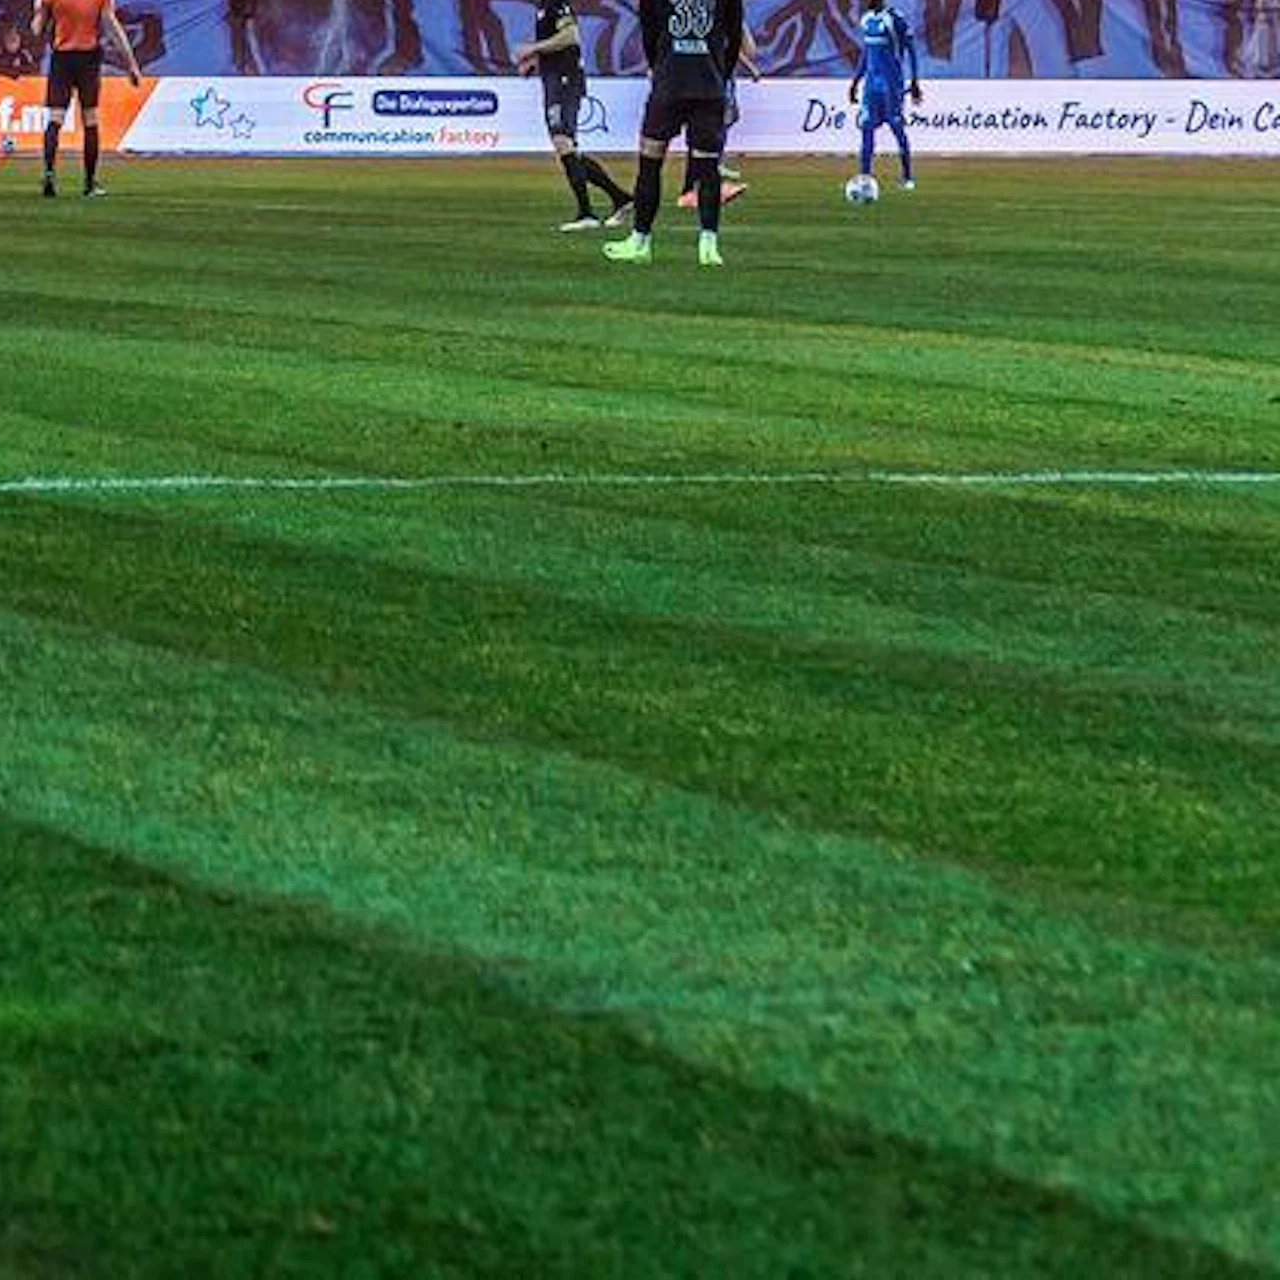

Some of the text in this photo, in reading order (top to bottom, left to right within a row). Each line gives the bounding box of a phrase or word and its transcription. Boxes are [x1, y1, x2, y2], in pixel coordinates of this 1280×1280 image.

[802, 98, 845, 133] Die
[855, 104, 1048, 132] munication
[1057, 100, 1158, 138] Factory
[1184, 100, 1244, 134] Dein
[303, 127, 500, 147] communication factory
